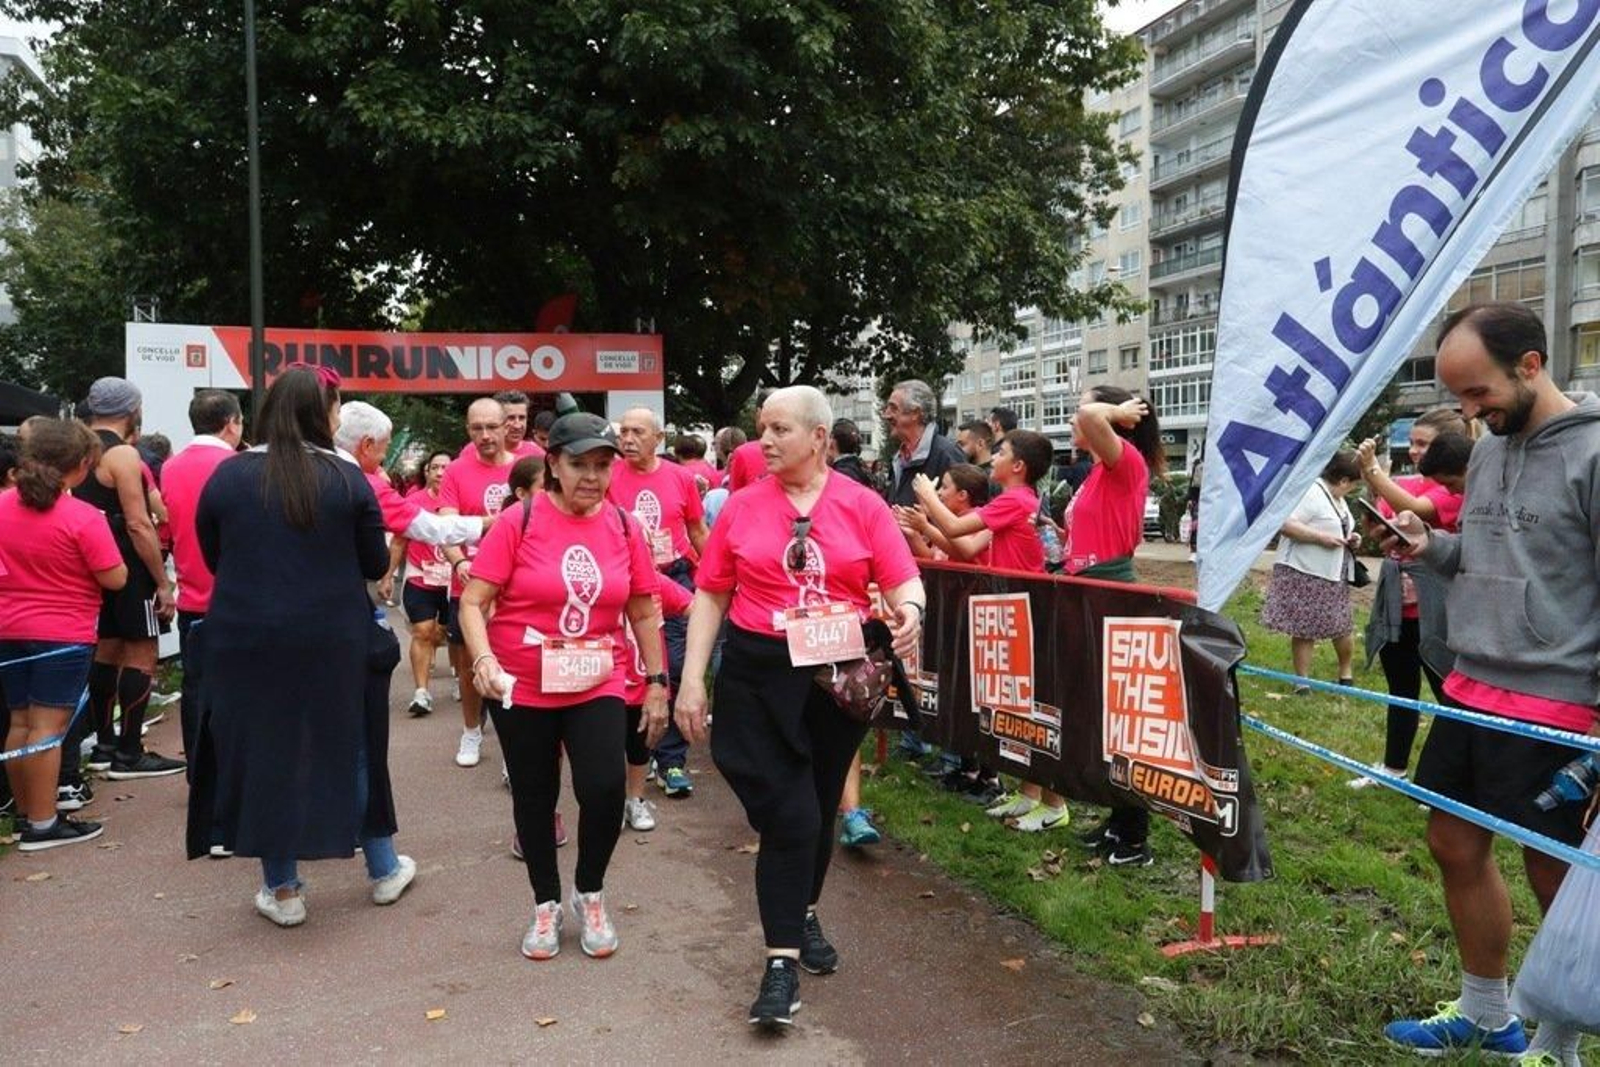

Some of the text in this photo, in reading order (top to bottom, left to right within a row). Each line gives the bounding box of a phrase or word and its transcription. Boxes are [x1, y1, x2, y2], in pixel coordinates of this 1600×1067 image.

[1217, 0, 1600, 526] Atlántico
[137, 346, 180, 355] CONCELLO
[804, 619, 849, 648] 3447
[974, 606, 1018, 637] SAVE
[976, 640, 1010, 671] THE
[976, 672, 1031, 707] MUSIC
[1111, 672, 1168, 715] THE
[1109, 711, 1193, 763] MUSIC
